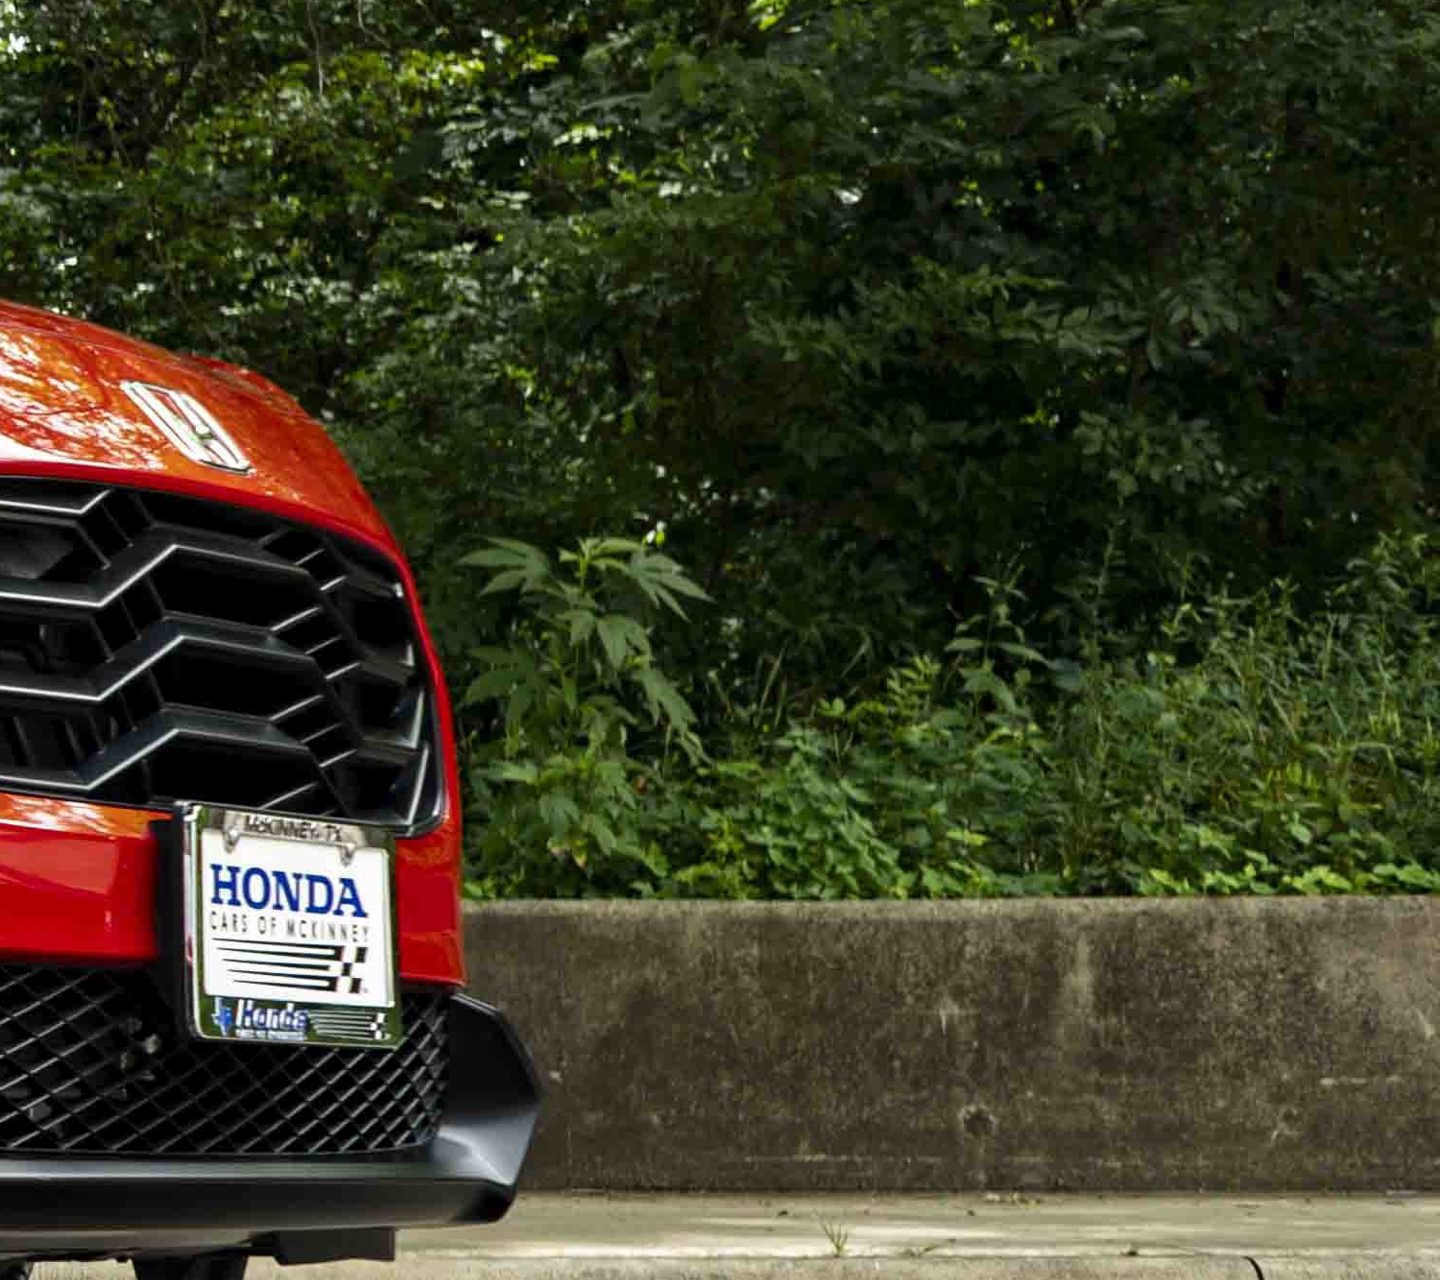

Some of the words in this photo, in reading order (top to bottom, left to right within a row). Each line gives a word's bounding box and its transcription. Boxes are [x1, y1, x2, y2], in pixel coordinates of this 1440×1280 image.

[210, 863, 368, 918] HONDA
[210, 910, 248, 932] CARS
[257, 915, 277, 935] OF
[287, 918, 369, 943] MCKINNEY
